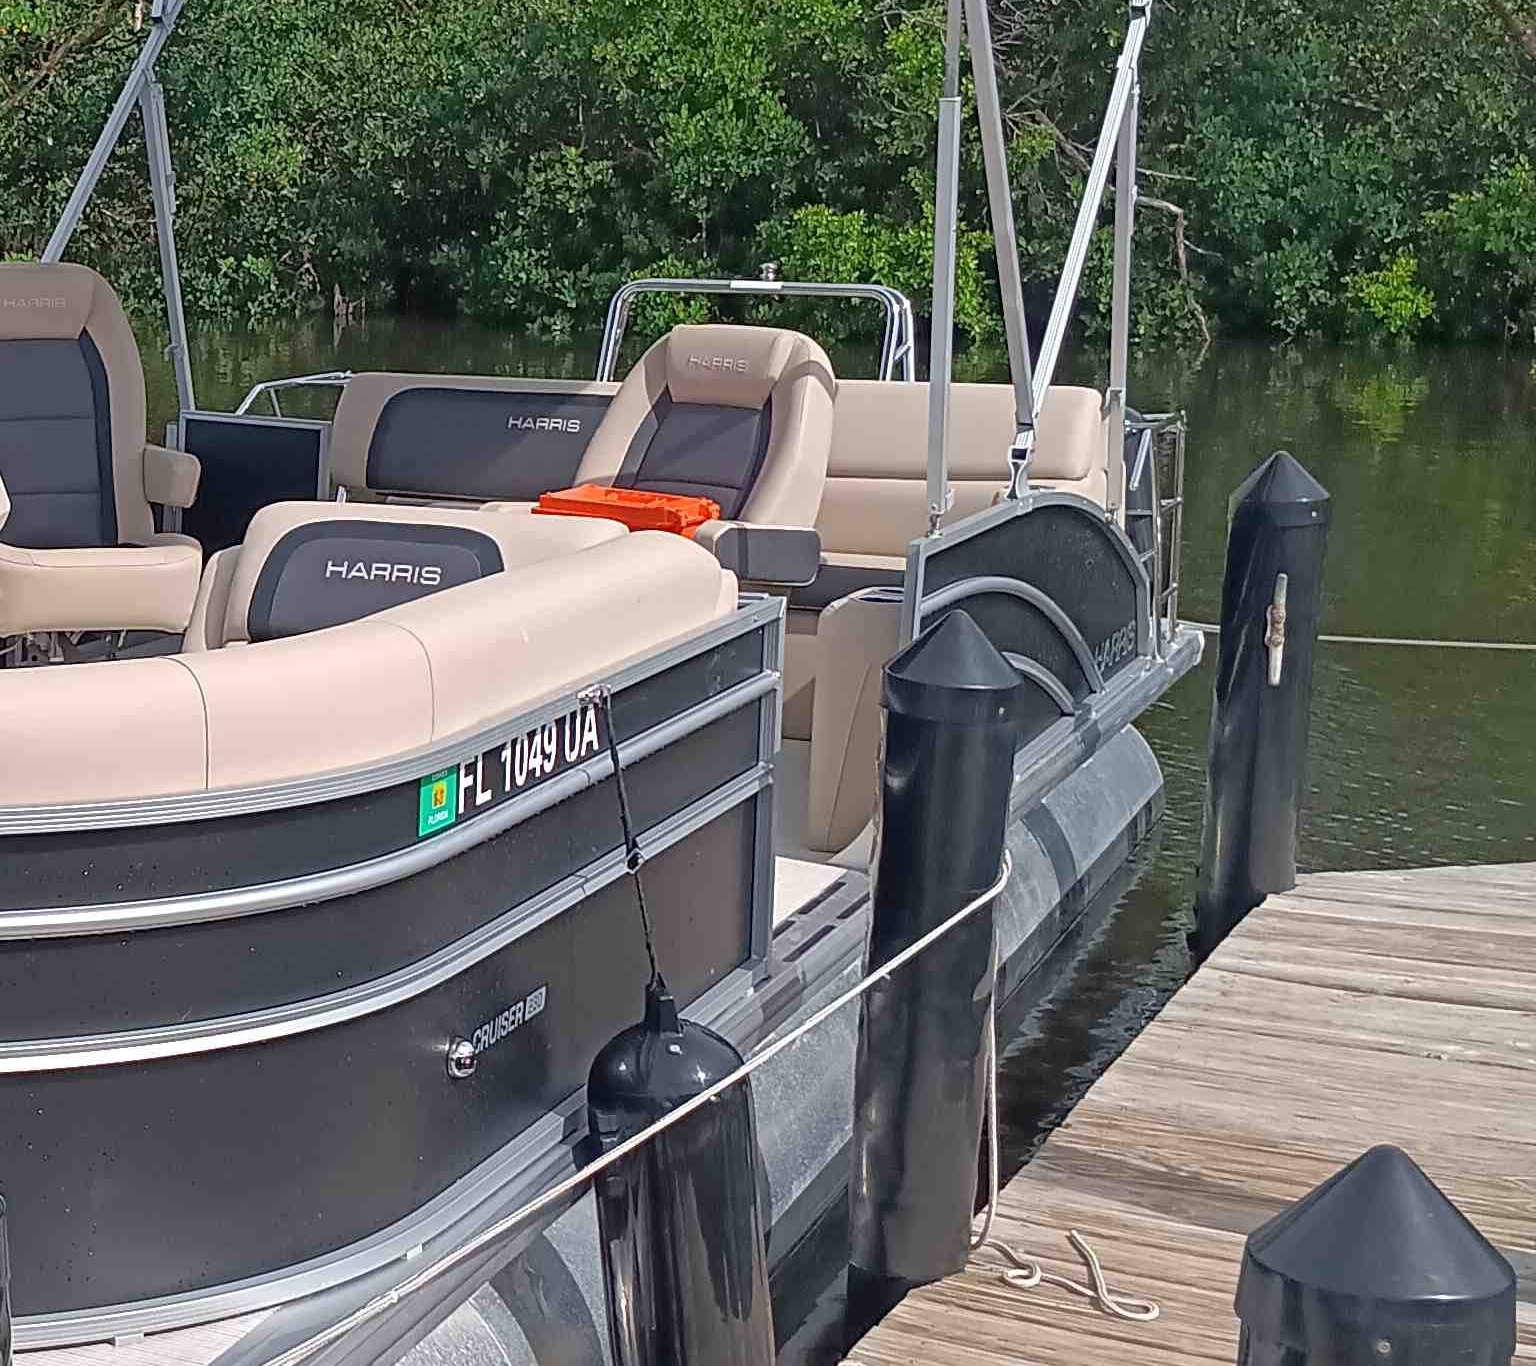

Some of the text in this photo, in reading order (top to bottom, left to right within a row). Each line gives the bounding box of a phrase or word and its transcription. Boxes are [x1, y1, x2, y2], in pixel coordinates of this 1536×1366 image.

[508, 416, 581, 433] HARRIS
[325, 560, 442, 585] HARRIS
[458, 700, 600, 814] FL 1049 UA
[472, 1000, 525, 1055] CRUISER
